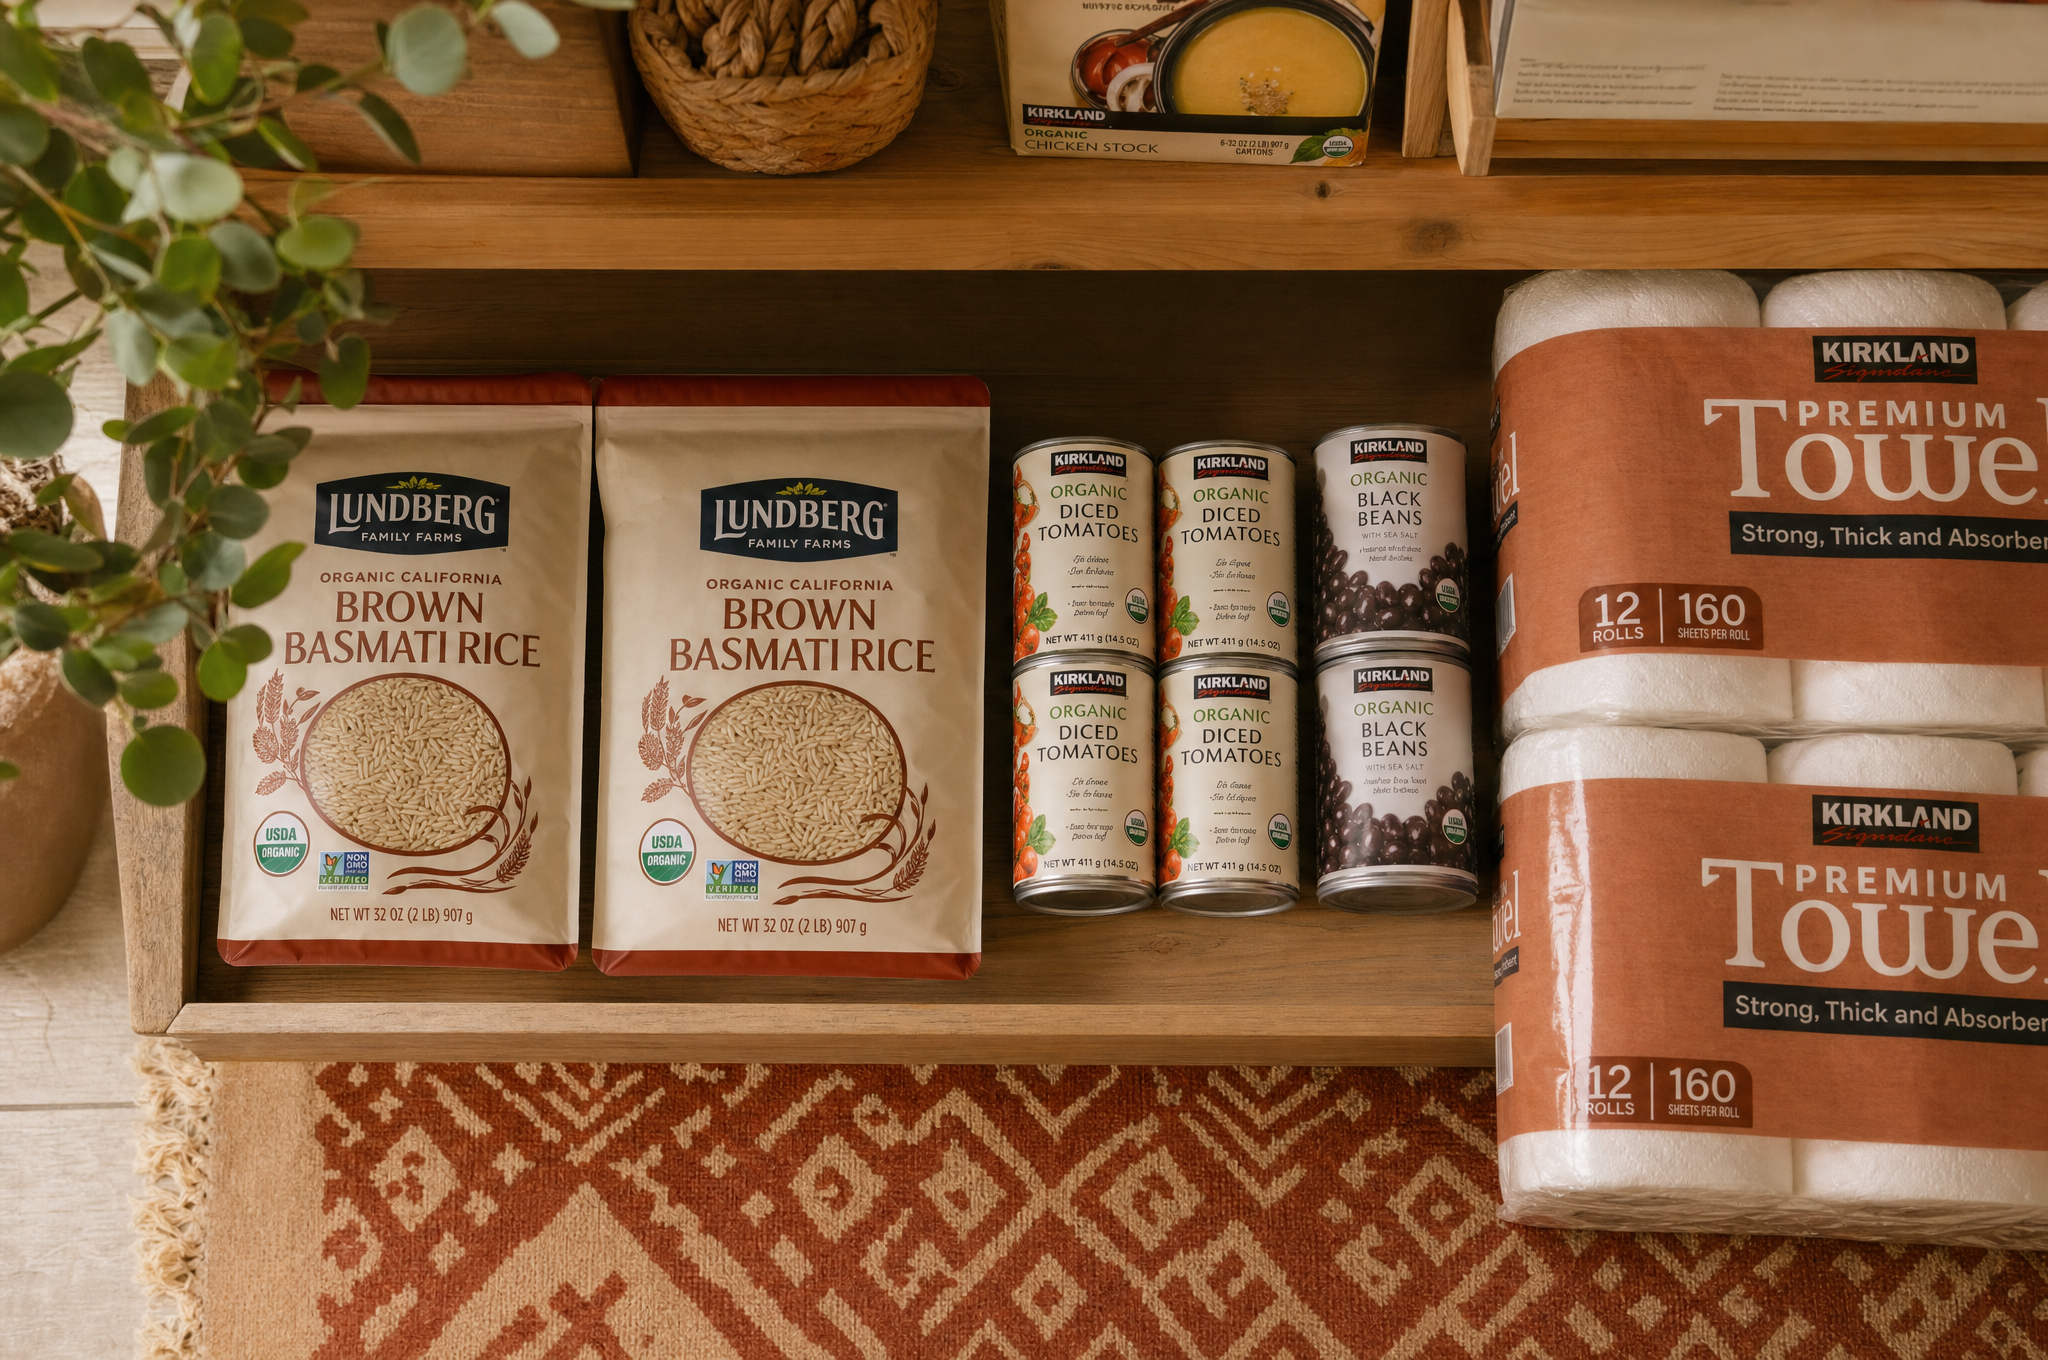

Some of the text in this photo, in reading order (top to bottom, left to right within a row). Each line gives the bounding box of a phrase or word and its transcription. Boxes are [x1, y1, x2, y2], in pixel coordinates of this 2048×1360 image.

[1027, 107, 1106, 121] KIRKLAND
[1024, 128, 1088, 139] ORGANIC
[1024, 139, 1158, 153] CHICKEN STOCK
[1822, 342, 1969, 364] KIRKLAND
[1800, 400, 2006, 429] PREMIUM
[1354, 441, 1424, 454] KIRKLAND
[1704, 397, 2048, 505] Towe
[1055, 453, 1124, 467] KIRKLAND
[1198, 457, 1266, 470] KIRKLAND
[1351, 471, 1428, 486] ORGANIC
[1050, 483, 1127, 500] ORGANIC
[1193, 487, 1269, 504] ORGANIC
[1358, 491, 1421, 507] BLACK
[329, 492, 496, 535] LUNDBERG
[1060, 503, 1119, 519] DICED
[1202, 507, 1260, 523] DICED
[1358, 510, 1422, 526] BEANS
[714, 499, 885, 541] LUNDBERG
[361, 532, 462, 543] FAMILY FARMS
[1038, 523, 1139, 543] TOMATOES
[1181, 526, 1280, 547] TOMATOES
[1742, 523, 1825, 548] Strong,
[1830, 525, 1892, 546] Thick
[1899, 527, 1942, 546] and
[748, 539, 851, 549] FAMILY FARMS
[320, 571, 502, 585] ORGANIC CALIFORNIA
[706, 578, 893, 591] ORGANIC CALIFORNIA
[335, 591, 484, 623] BROWN
[723, 598, 876, 631] BROWN
[1595, 591, 1746, 627] 12 160
[1046, 633, 1140, 648] NET WT 411 g (14.5 OZ)
[1593, 627, 1750, 642] ROLLS SHEETS PER ROLL
[284, 630, 541, 668] BASMATI RICE
[1188, 638, 1280, 651] NET WT 411 g (14.5 OZ)
[669, 637, 936, 673] BASMATI RICE
[1054, 673, 1124, 687] KIRKLAND
[1198, 677, 1267, 690] KIRKLAND
[1358, 670, 1430, 683] KIRKLAND
[1049, 704, 1127, 721] ORGANIC
[1193, 707, 1270, 724] ORGANIC
[1354, 701, 1434, 716] ORGANIC
[1059, 724, 1118, 740] DICED
[1202, 728, 1262, 744] DICED
[1362, 721, 1427, 738] BLACK
[1037, 744, 1138, 764] TOMATOES
[1362, 741, 1428, 757] BEANS
[1181, 748, 1281, 767] TOMATOES
[1822, 802, 1972, 831] KIRKLAND
[265, 827, 297, 841] USDA
[651, 835, 683, 850] USDA
[261, 846, 300, 859] ORGANIC
[647, 854, 686, 867] ORGANIC
[1044, 858, 1139, 872] NET WT 411 g (14.5 OZ)
[1187, 862, 1281, 875] NET WT 411 g (14.5 OZ)
[1796, 865, 2006, 902] PREMIUM
[330, 907, 473, 925] NET WT 32 OZ (2 LB) 907 g
[1702, 858, 2048, 983] Towe
[718, 918, 867, 936] NET WT 32 OZ (2 LB) 907 g
[1735, 995, 1820, 1023] Strong,
[1825, 1001, 1888, 1023] Thick
[1894, 1006, 1938, 1026] and
[1588, 1065, 1735, 1102] 12 160
[1585, 1101, 1739, 1118] ROLLS SHEETS PER ROLL
